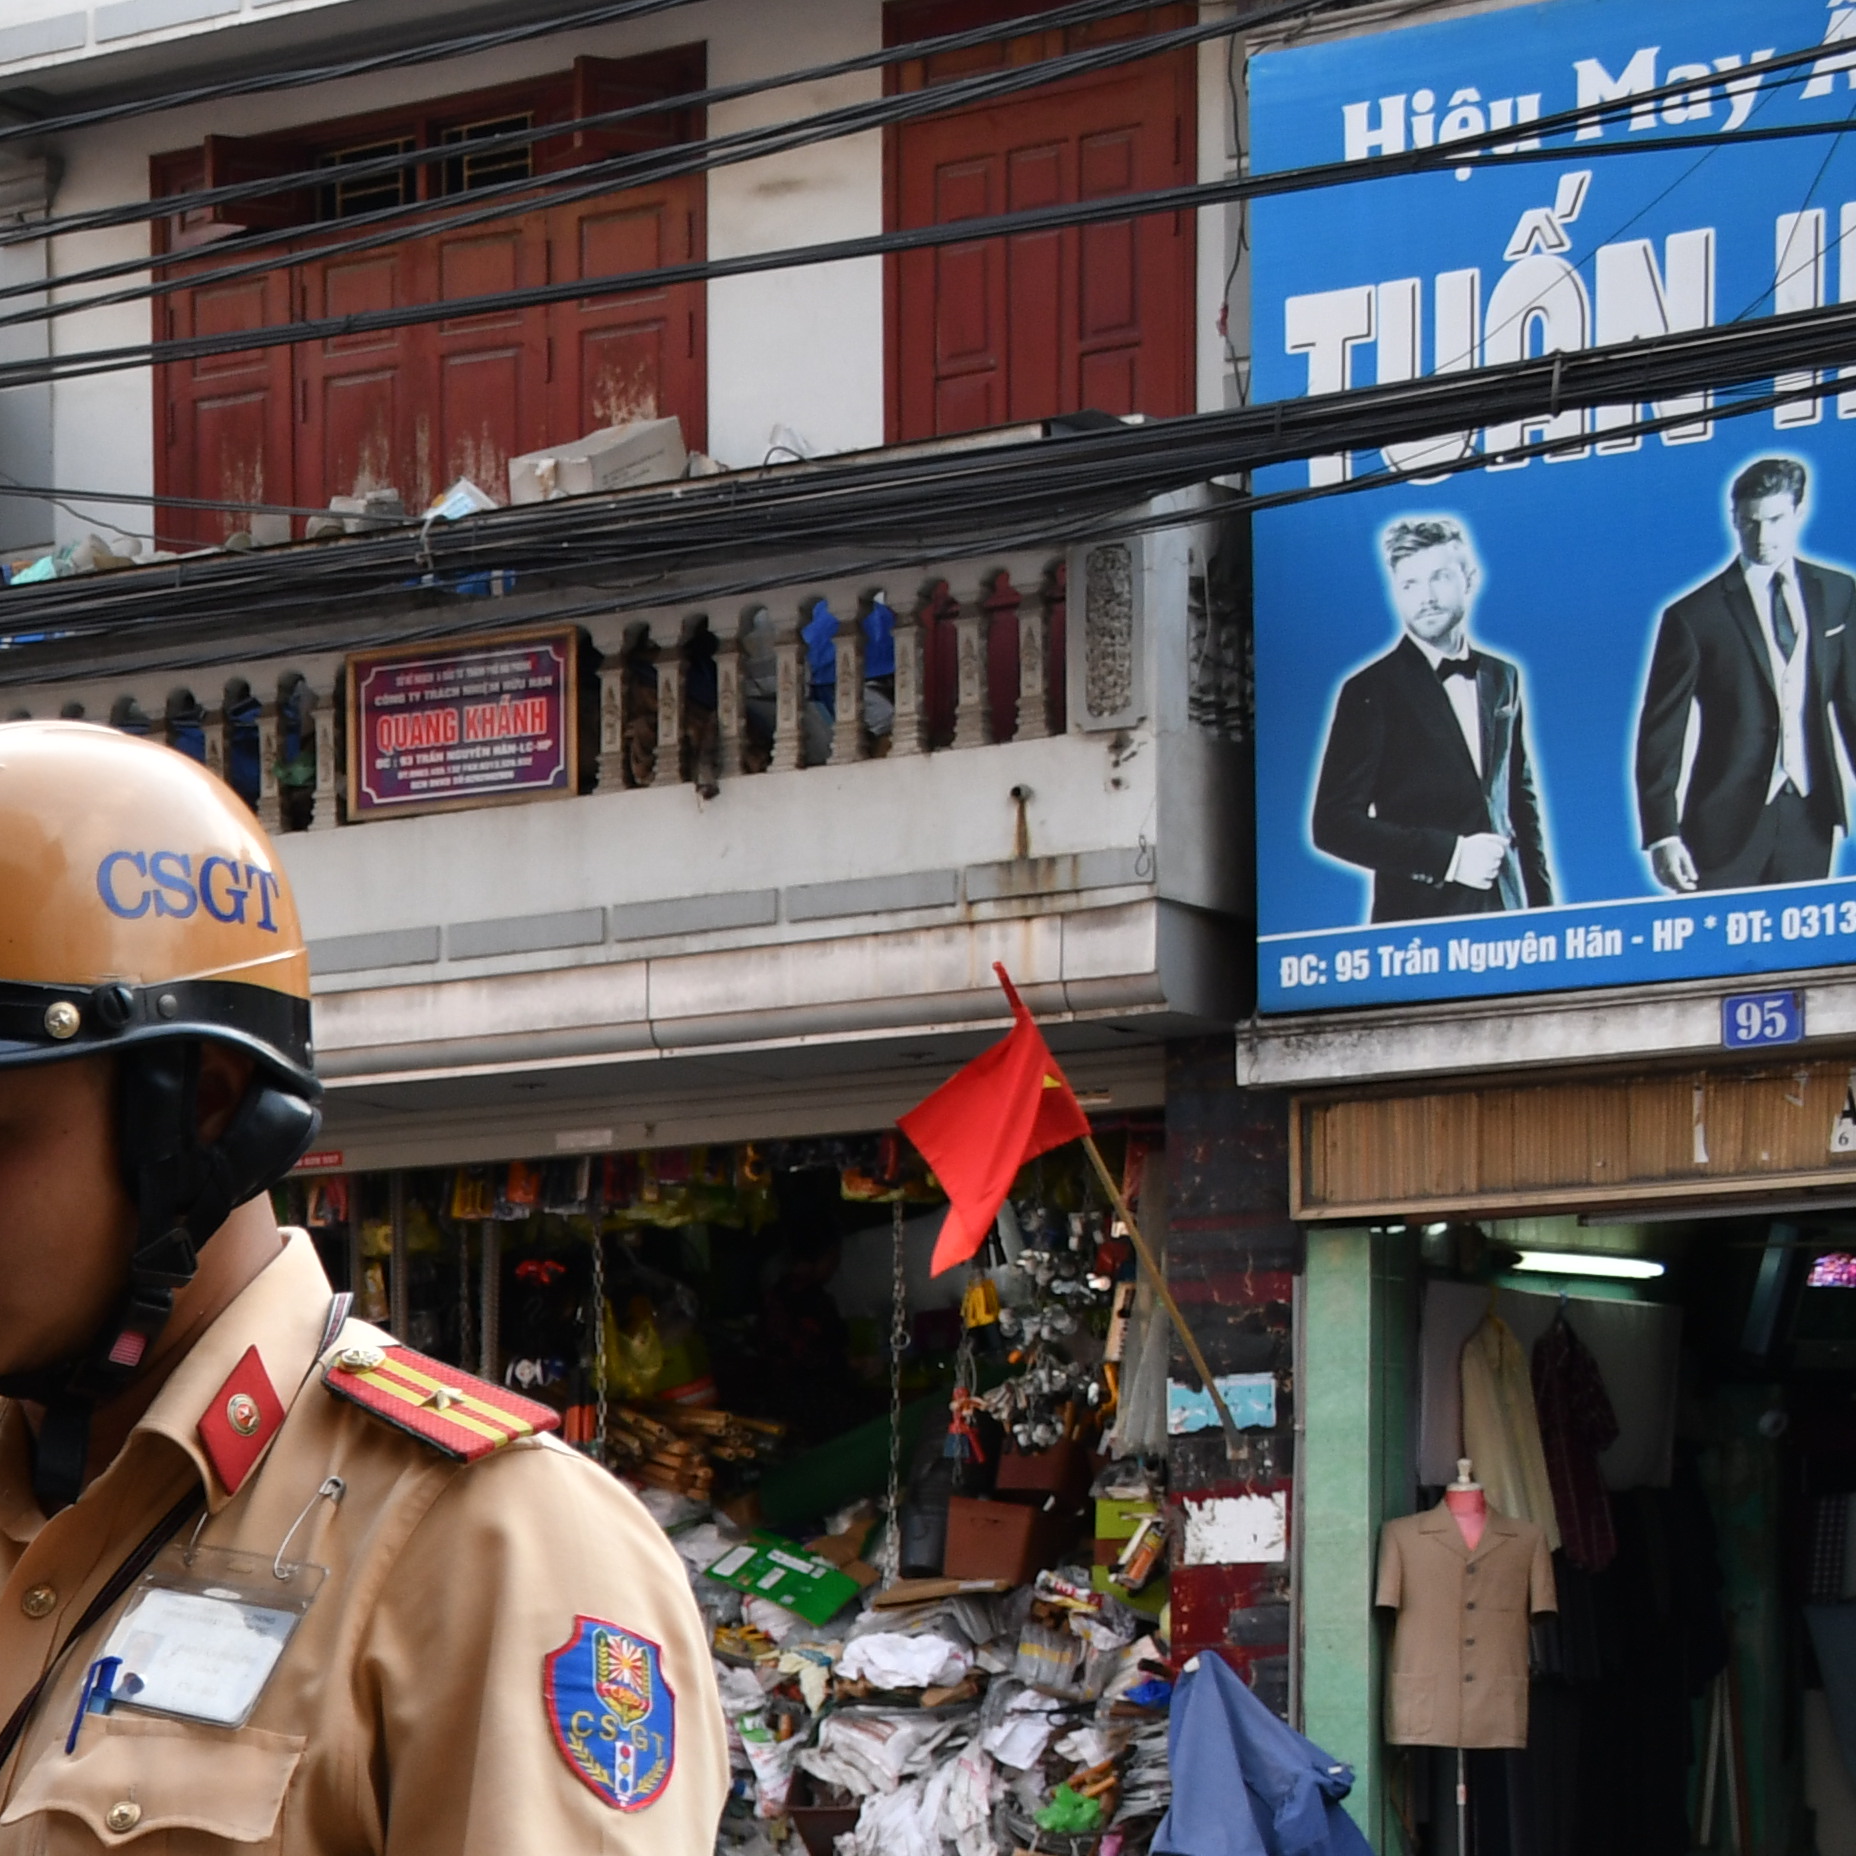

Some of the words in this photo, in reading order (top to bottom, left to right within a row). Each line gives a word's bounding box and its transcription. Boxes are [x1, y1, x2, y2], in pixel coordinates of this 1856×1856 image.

[1573, 46, 1775, 141] May
[377, 708, 460, 755] QUANG
[463, 694, 549, 742] KHÁNH
[98, 849, 279, 933] CSGT
[1279, 955, 1327, 986] ĐC:
[1335, 948, 1372, 982] 95
[1378, 939, 1440, 976] Trần
[1447, 930, 1557, 974] Nguyên
[1565, 923, 1623, 959] Hãn
[1652, 917, 1694, 951] HP
[1725, 911, 1773, 945] ĐT:
[1735, 998, 1788, 1042] 95
[571, 1710, 664, 1758] CSGT
